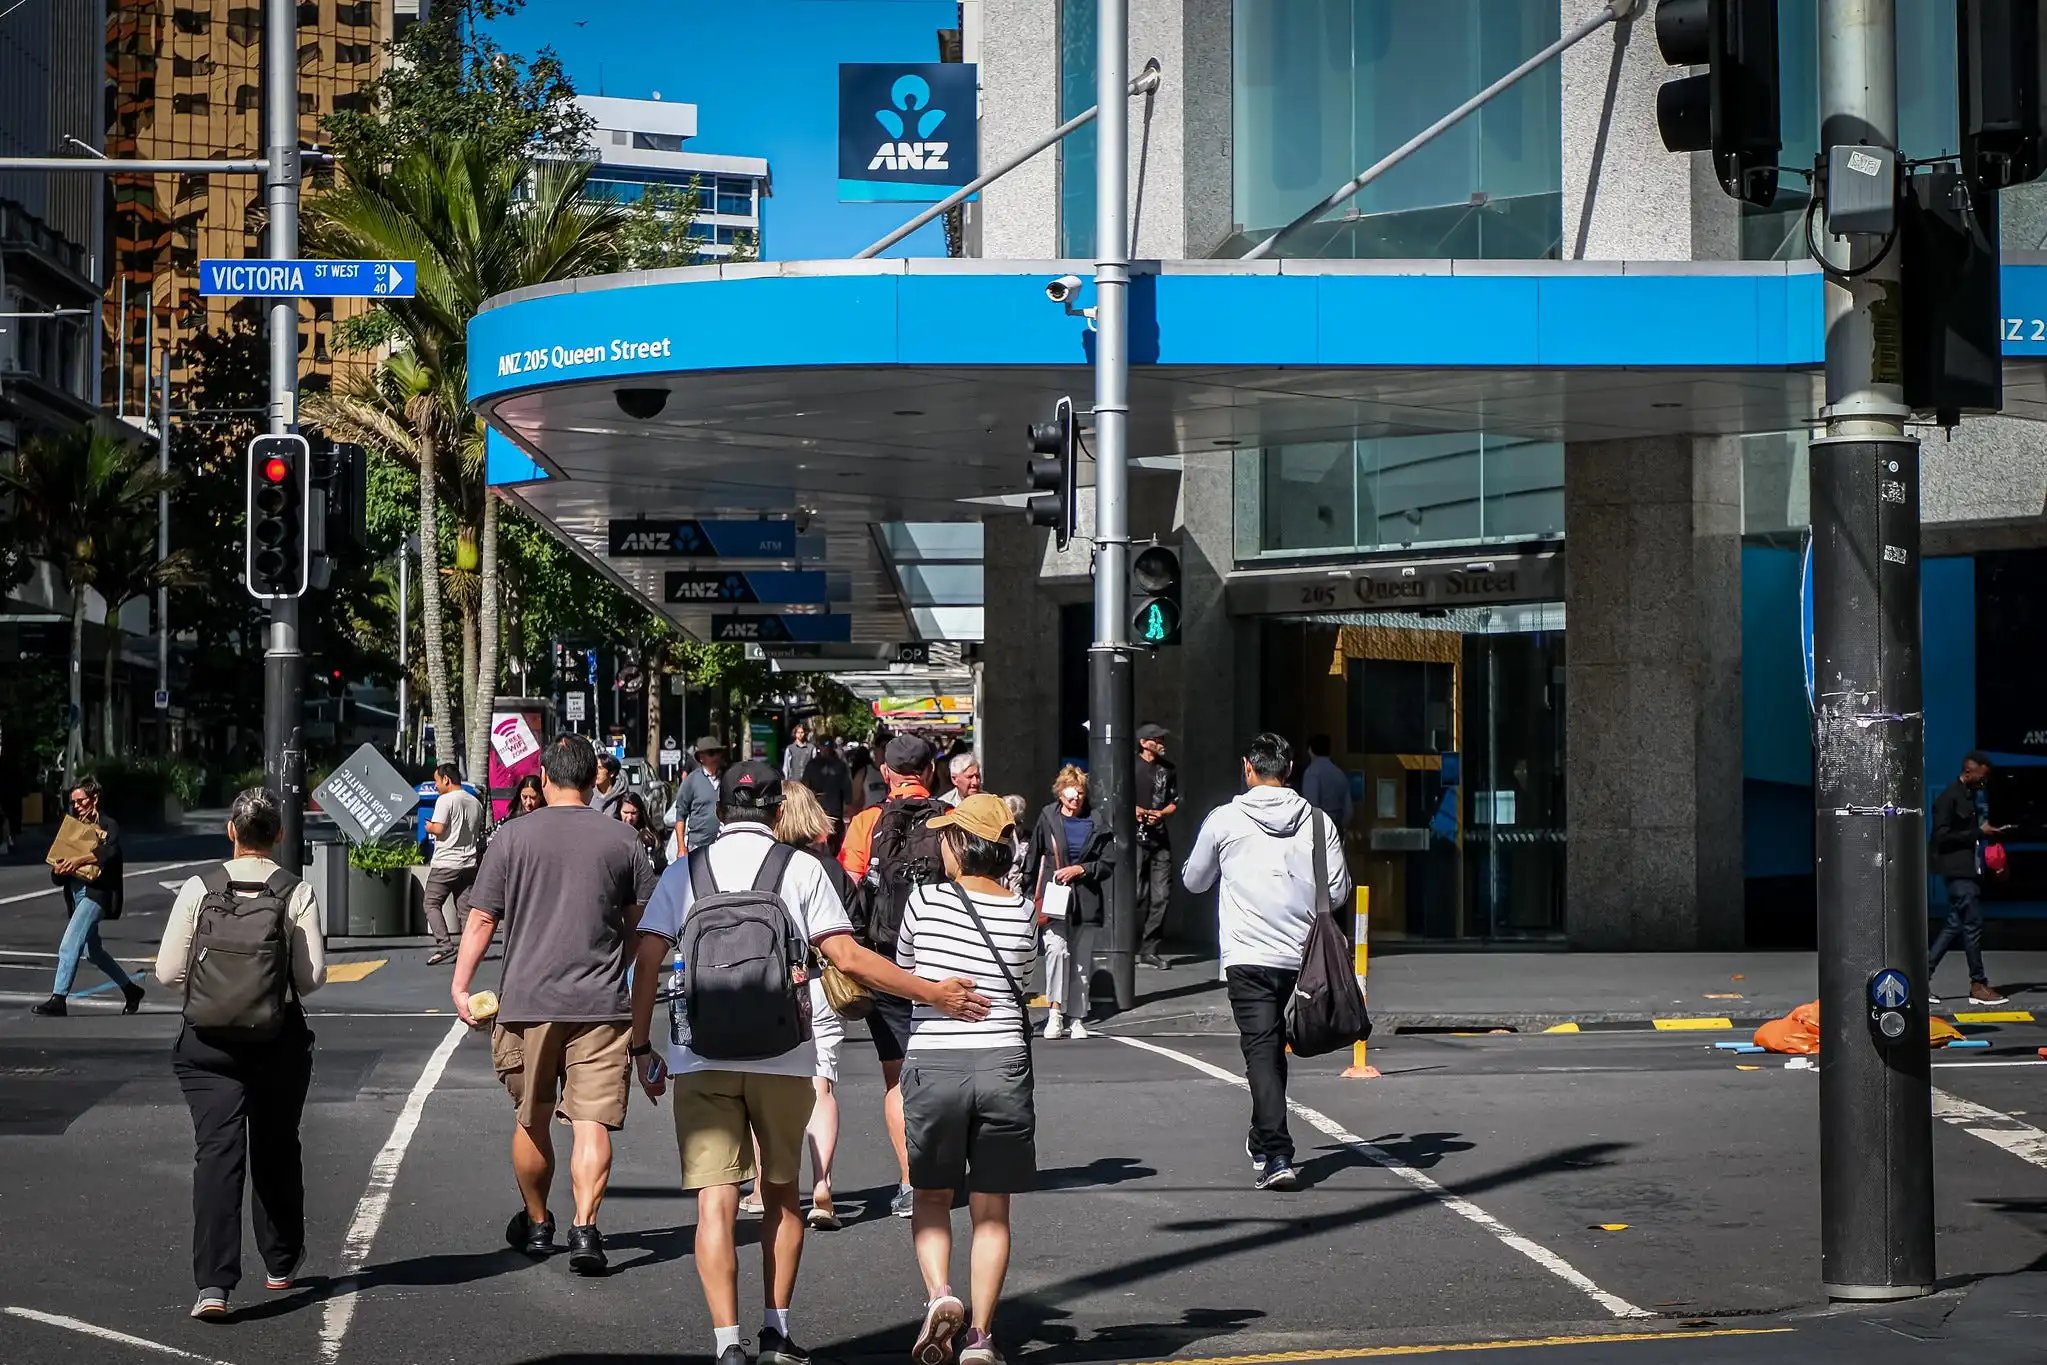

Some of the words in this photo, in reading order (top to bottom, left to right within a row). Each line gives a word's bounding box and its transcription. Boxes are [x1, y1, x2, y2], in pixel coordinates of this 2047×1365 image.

[867, 142, 949, 170] ANZ
[212, 266, 304, 291] VICTORIA
[314, 265, 328, 277] ST
[331, 265, 359, 278] WEST
[374, 264, 387, 275] 20
[373, 283, 387, 295] 40
[497, 352, 522, 377] ANZ
[523, 348, 549, 372] 205
[551, 345, 606, 369] Queen
[610, 337, 671, 361] Street
[620, 532, 671, 550] ANZ
[759, 540, 782, 551] ATM
[675, 582, 719, 598] ANZ
[1301, 585, 1337, 606] 205
[1353, 575, 1425, 604] Queen
[1445, 570, 1517, 596] Street
[720, 623, 759, 638] ANZ
[370, 799, 393, 823] 0508
